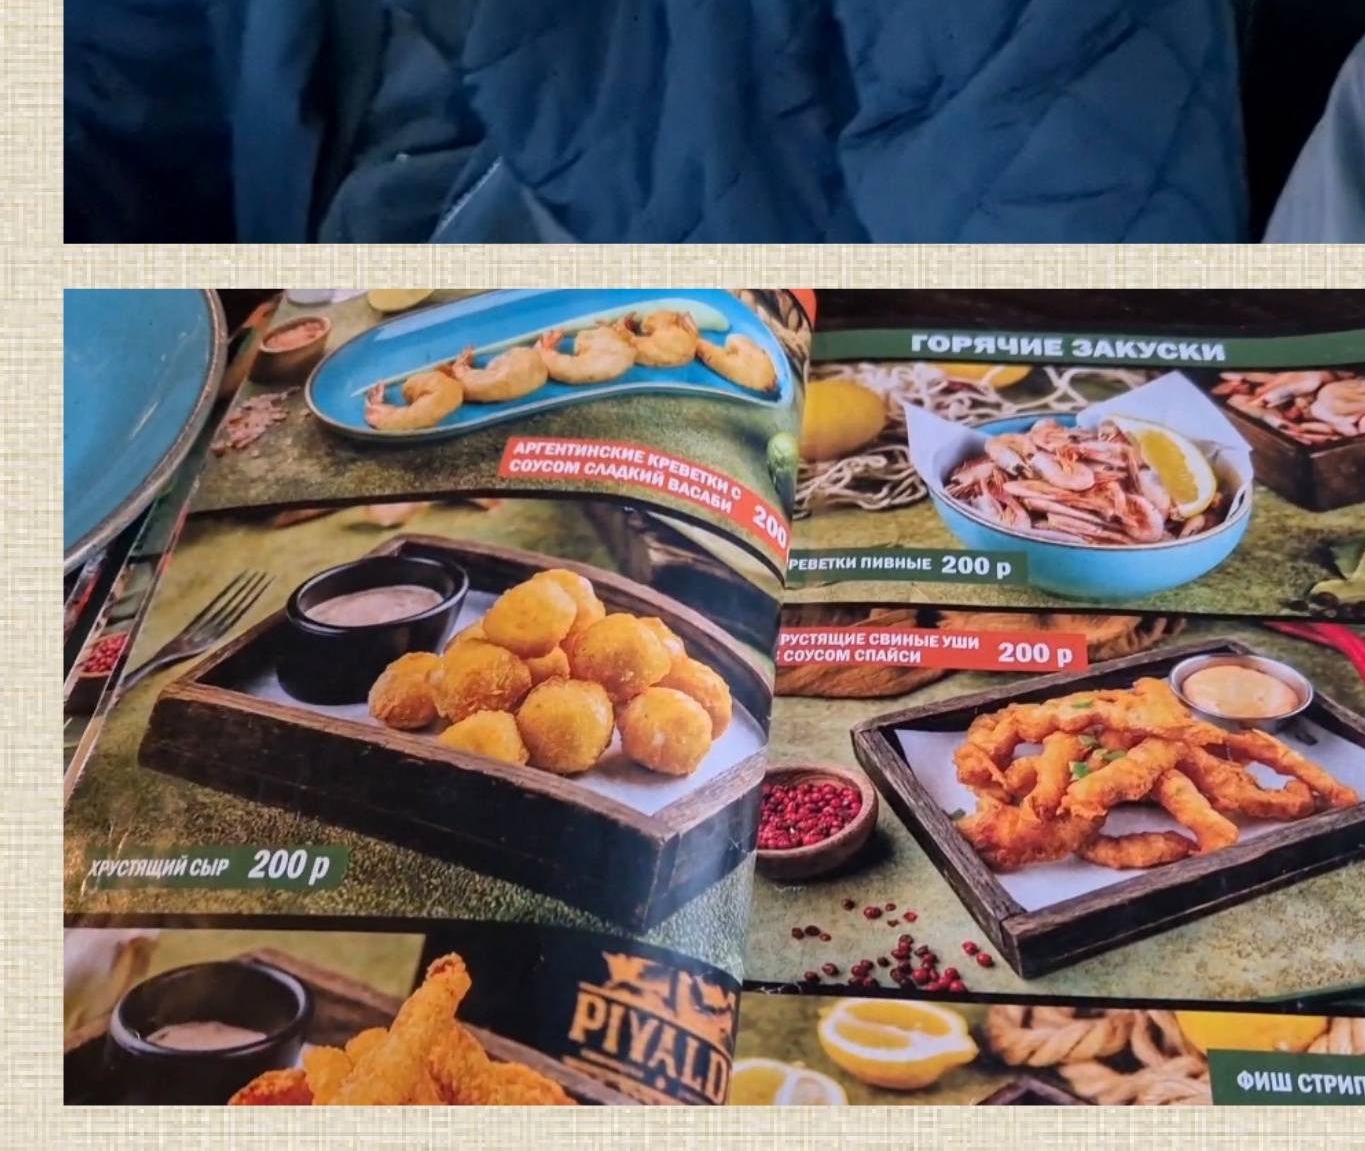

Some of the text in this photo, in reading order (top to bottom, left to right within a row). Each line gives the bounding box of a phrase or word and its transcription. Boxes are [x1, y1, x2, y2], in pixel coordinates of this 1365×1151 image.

[911, 334, 1226, 361] ГОРЯЧИЕ ЗАКУСКИ
[513, 441, 742, 500] АРГЕНТИНСКИЕ КРЕВЕТКИ С
[508, 458, 732, 514] СОУСОМ СЛАДКИЙ ВАСАБИ
[751, 505, 788, 549] 200
[788, 555, 1011, 579] РЕВЕТКИ ПИВНЫЕ 200 р
[780, 632, 980, 650] РУСТЯЩИЕ СВИНЫЕ УШИ
[783, 649, 850, 662] СОУСОМ
[854, 649, 922, 664] СПАЙСИ
[997, 642, 1073, 667] 200 р
[88, 850, 330, 886] ХРУСТЯЩИЙ СЫР 200 р
[1236, 1070, 1293, 1092] ФИШ
